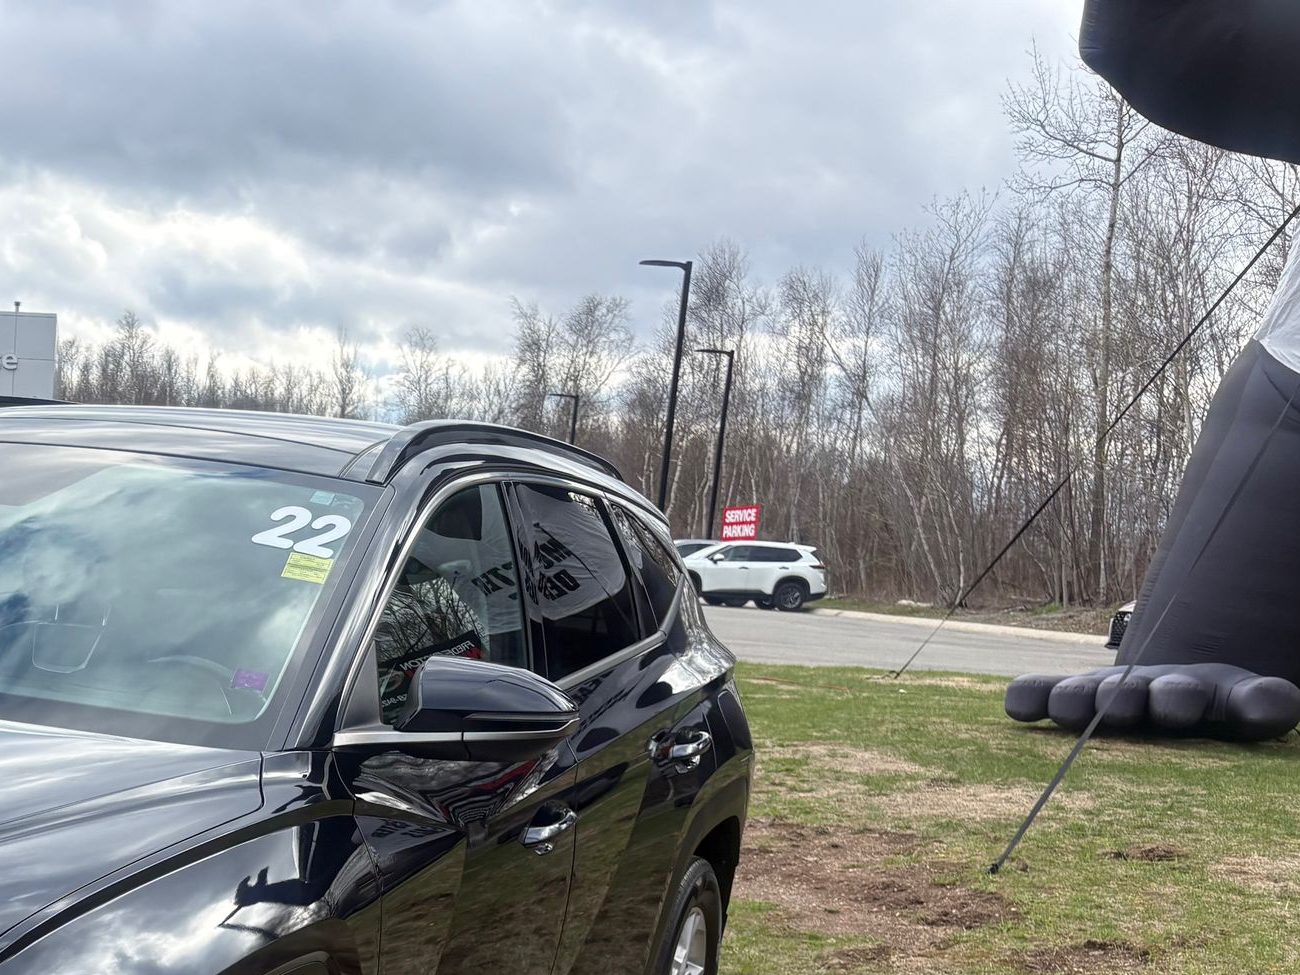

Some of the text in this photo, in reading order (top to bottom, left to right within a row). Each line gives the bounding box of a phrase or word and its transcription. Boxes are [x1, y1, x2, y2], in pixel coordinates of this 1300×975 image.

[725, 508, 757, 523] SERVICE
[251, 505, 352, 559] 22
[722, 524, 755, 538] PARKING
